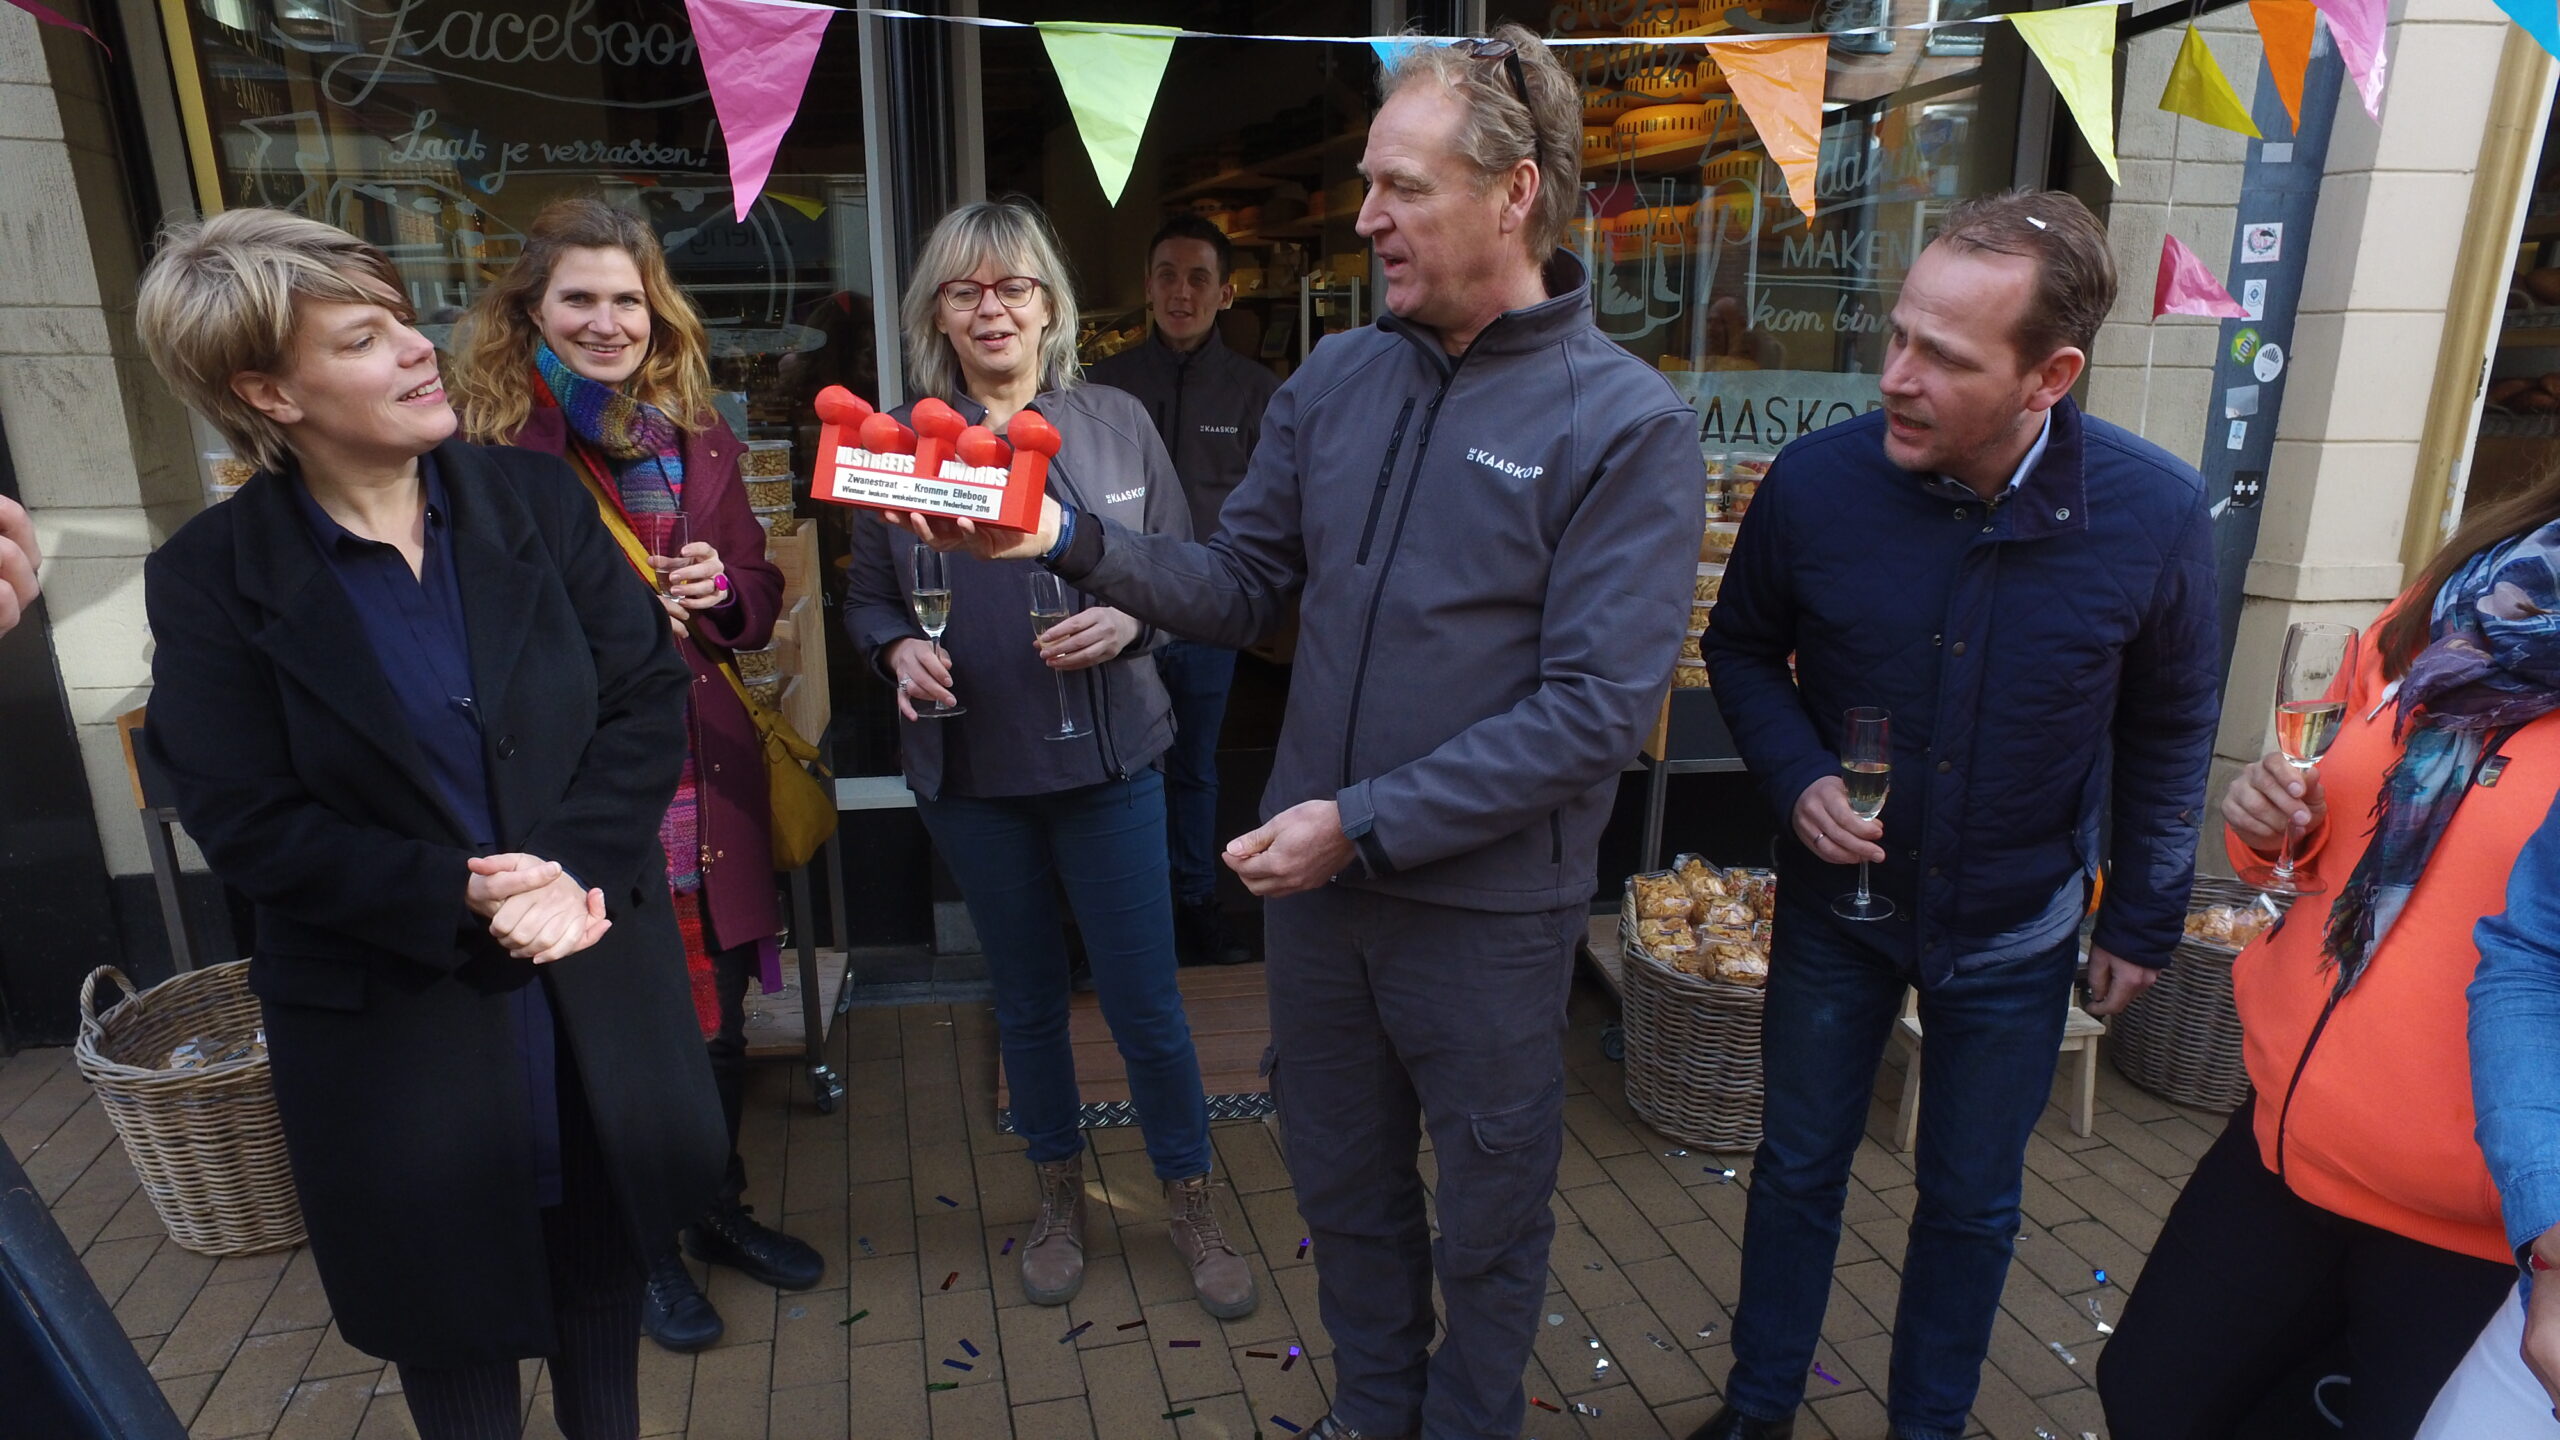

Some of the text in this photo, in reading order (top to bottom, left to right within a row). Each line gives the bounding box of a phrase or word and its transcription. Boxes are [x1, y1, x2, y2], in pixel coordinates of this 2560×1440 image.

[389, 108, 716, 194] Laat je verrassen!
[1782, 229, 1914, 271] MAKEN
[1752, 287, 1825, 333] kom
[1688, 395, 1882, 446] AASKO
[938, 459, 1009, 488] AWARDS
[1476, 449, 1544, 478] KAASKOP
[847, 473, 898, 489] Zwanestraat
[914, 483, 948, 497] Kromme
[953, 488, 988, 504] Elleboog
[943, 500, 973, 511] Nederland
[975, 504, 990, 513] 2016
